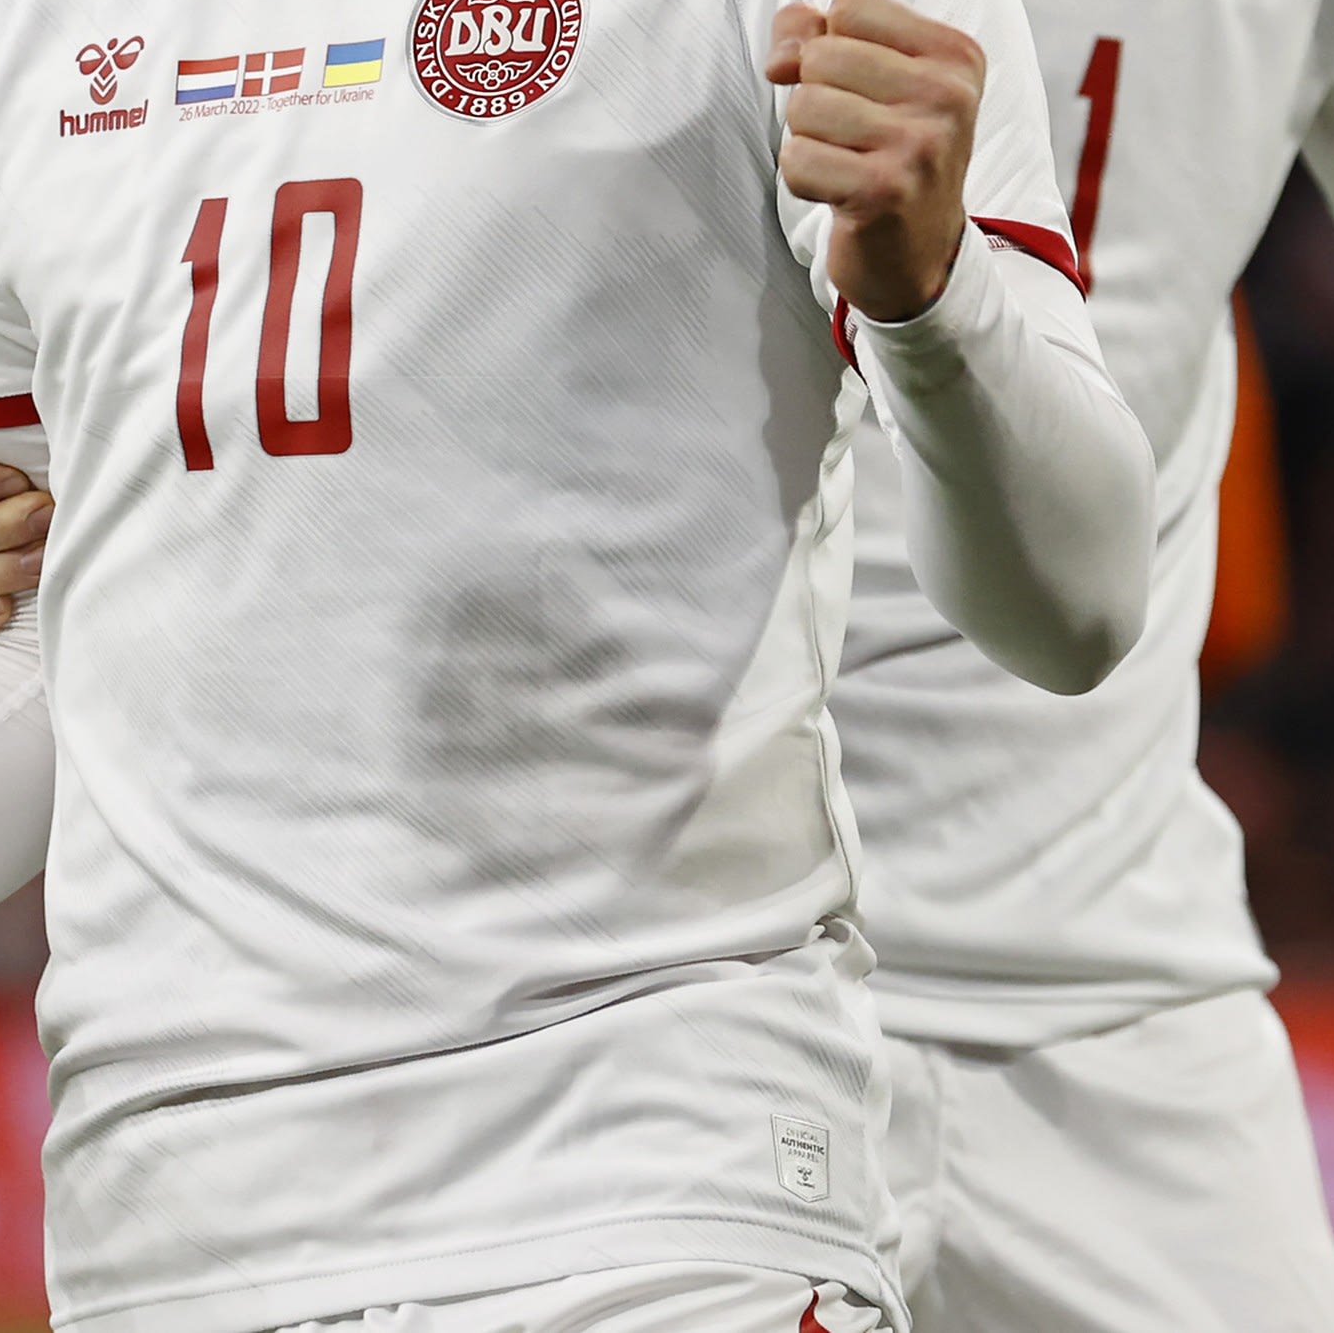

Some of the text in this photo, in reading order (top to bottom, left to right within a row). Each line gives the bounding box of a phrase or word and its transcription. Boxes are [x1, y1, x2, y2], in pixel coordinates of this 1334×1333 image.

[417, 0, 453, 99] DANSK
[444, 5, 551, 57] DBU
[60, 99, 149, 138] hummel
[179, 107, 193, 122] 26
[194, 101, 228, 119] March
[230, 100, 259, 115] 2022
[267, 92, 314, 112] Together
[316, 89, 332, 105] for
[334, 87, 375, 104] Ukraine
[455, 91, 526, 116] 1889
[176, 177, 363, 472] 10
[781, 1136, 825, 1156] AUTHENTIC
